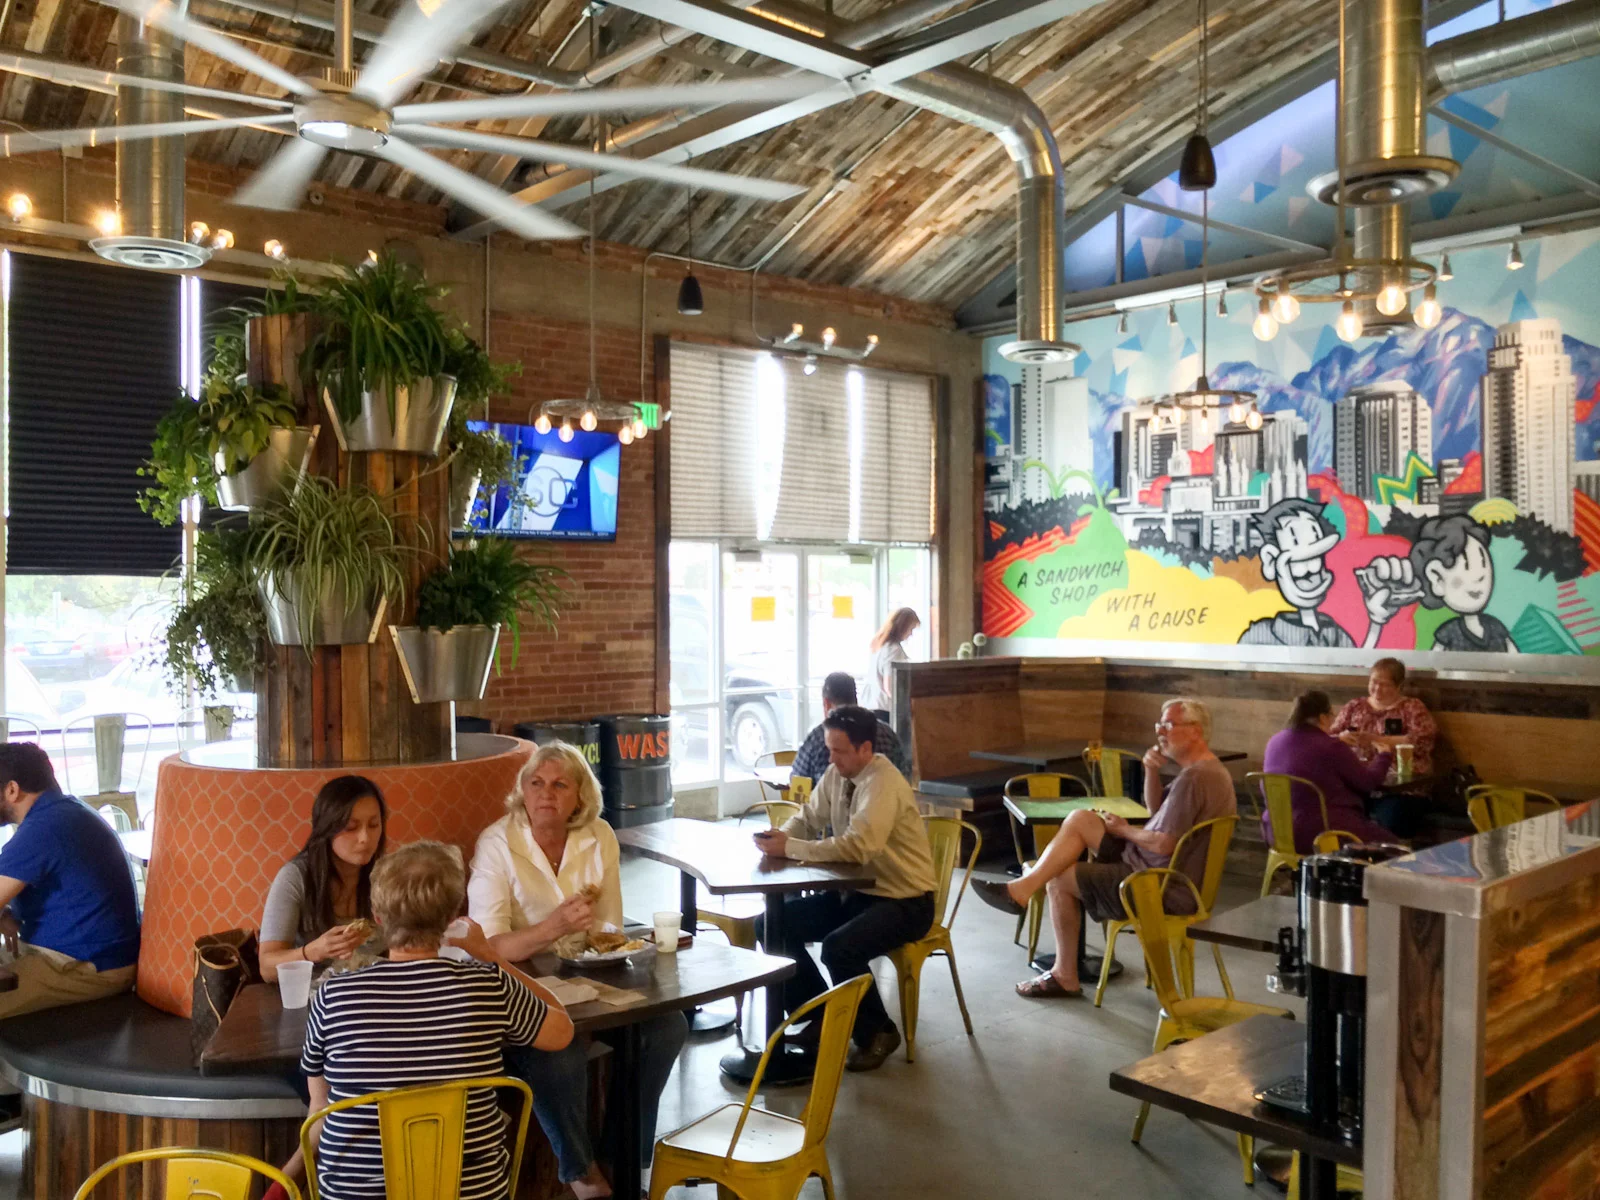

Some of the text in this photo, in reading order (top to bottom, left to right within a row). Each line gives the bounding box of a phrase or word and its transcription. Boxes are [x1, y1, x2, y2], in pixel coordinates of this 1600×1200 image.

[1017, 560, 1124, 588] A SANDWICH
[1050, 584, 1098, 605] SHOP
[1106, 592, 1156, 613] WITH
[1128, 606, 1209, 632] A CAUSE
